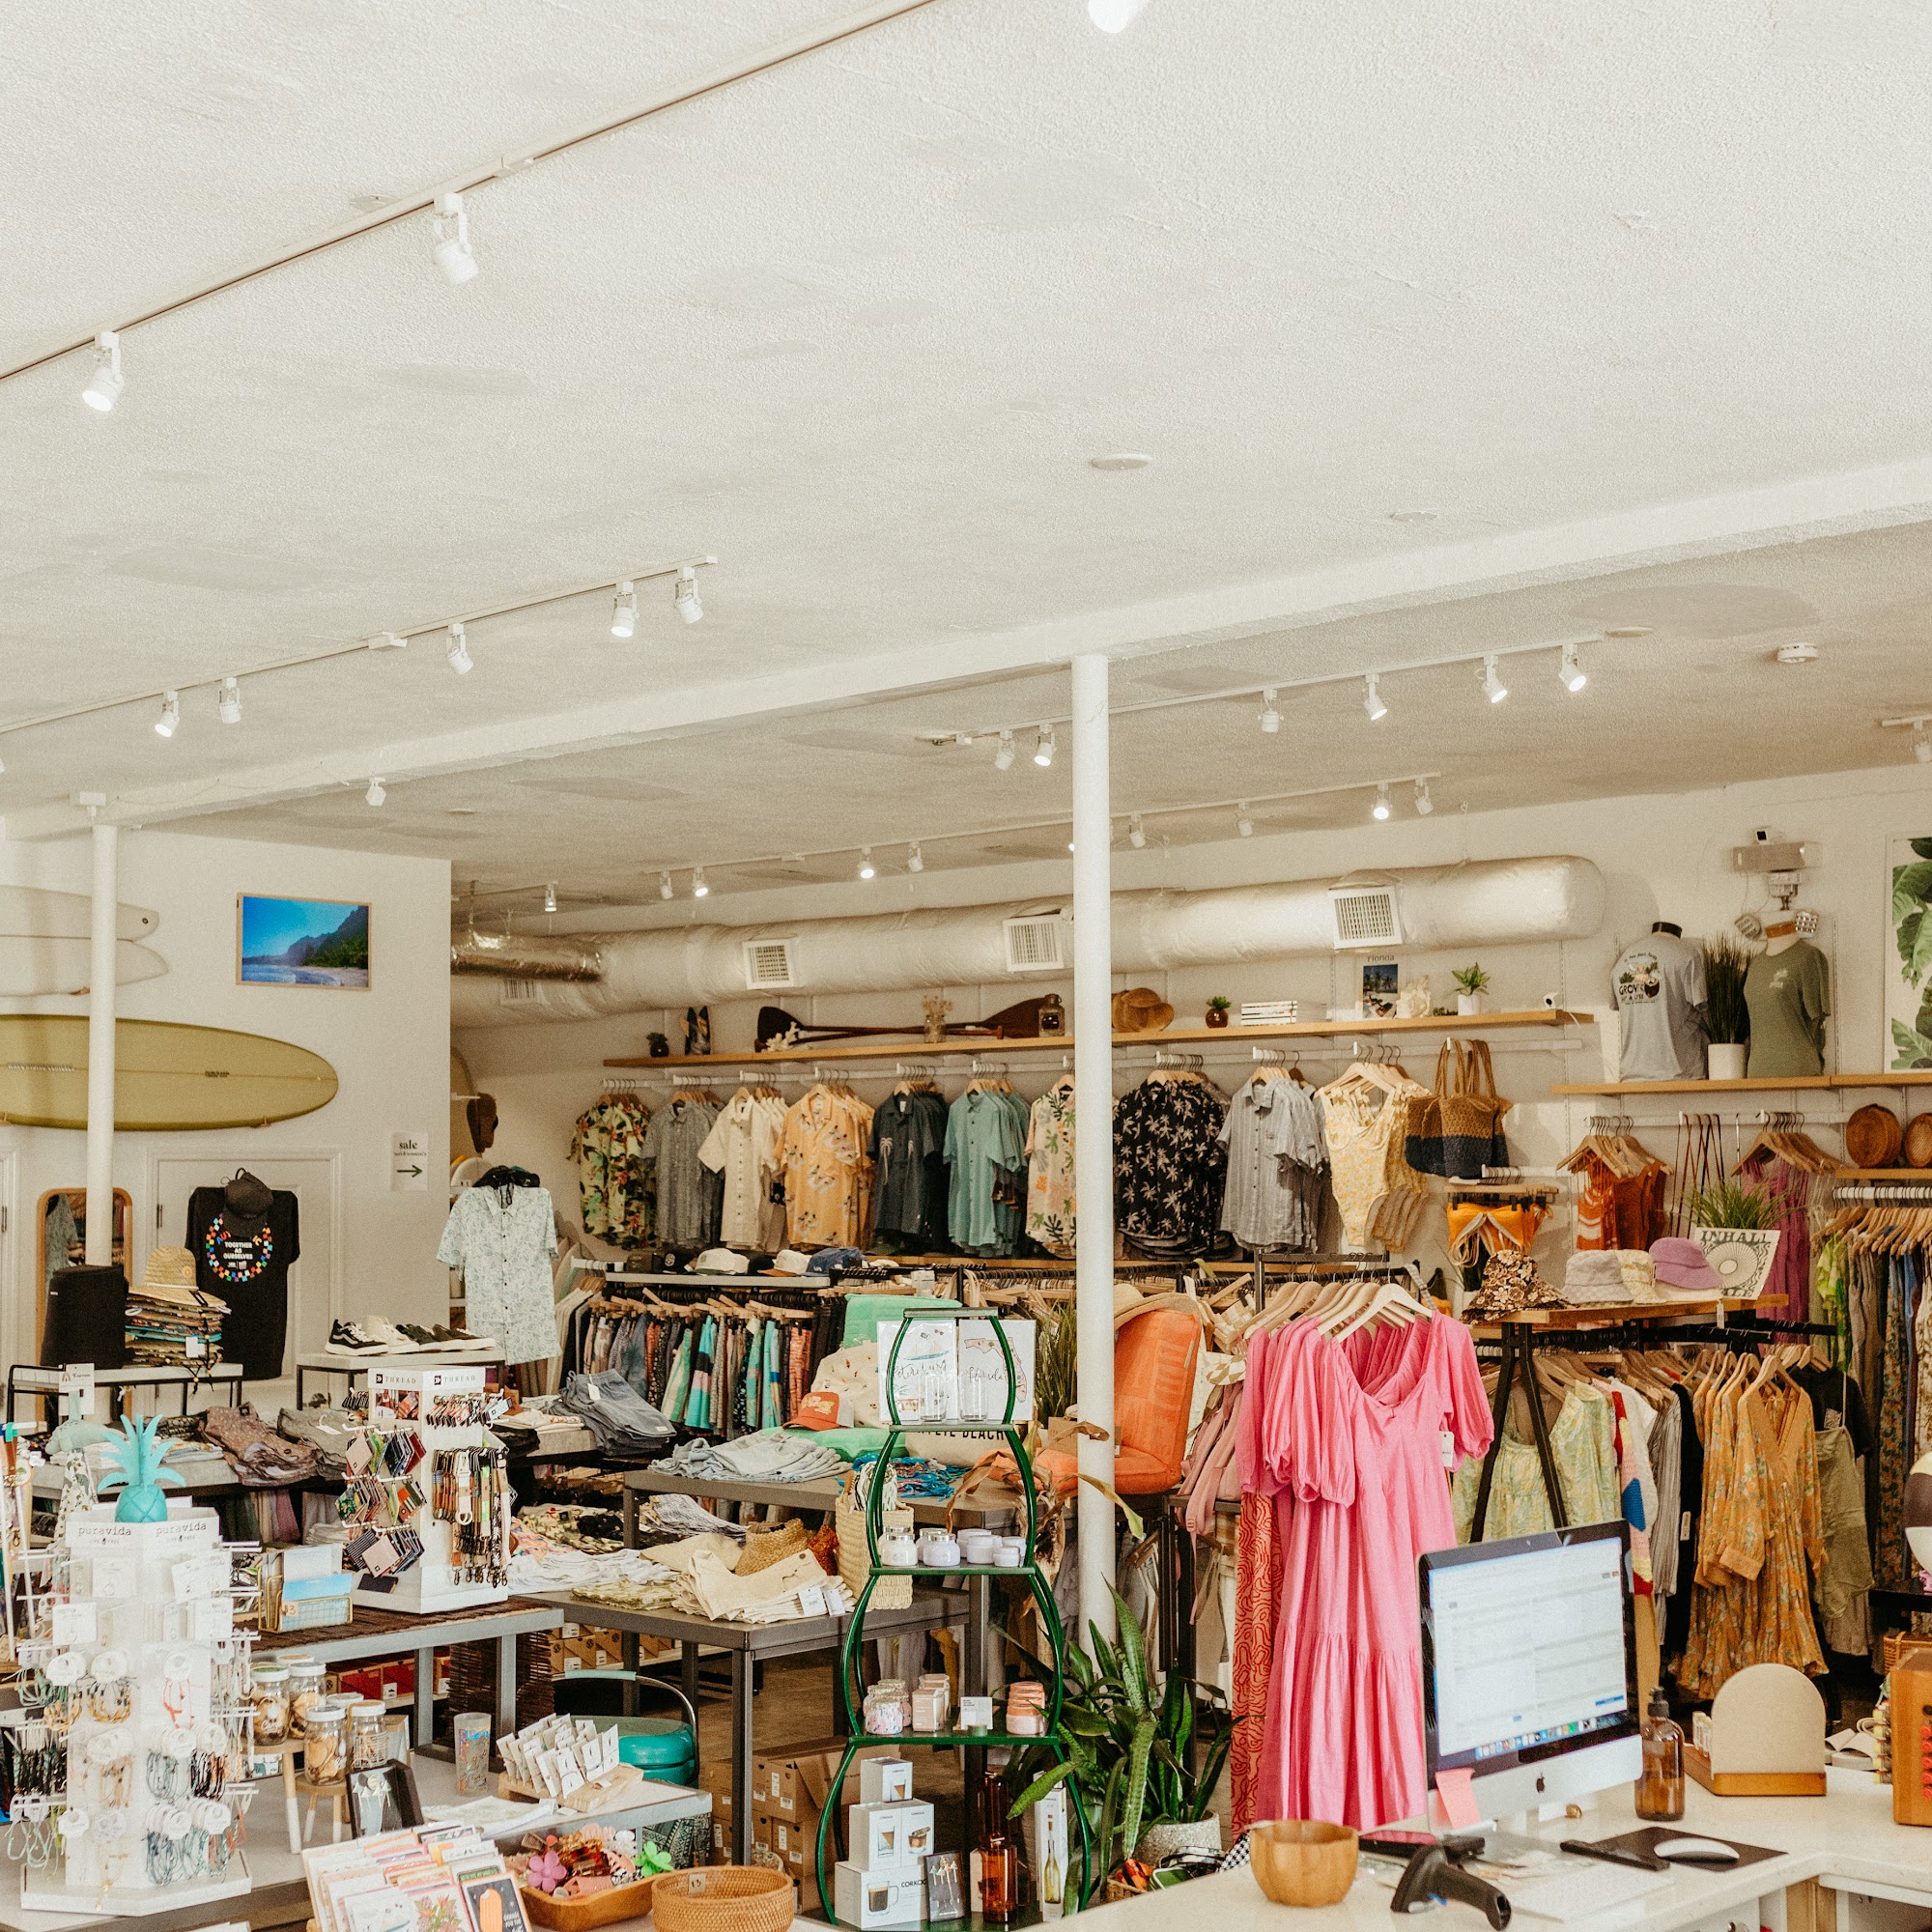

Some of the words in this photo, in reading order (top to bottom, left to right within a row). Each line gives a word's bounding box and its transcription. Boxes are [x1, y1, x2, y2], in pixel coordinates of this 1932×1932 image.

[399, 1140, 417, 1150] sale
[385, 1376, 416, 1384] THREAD
[444, 1375, 476, 1383] THREAD
[78, 1526, 131, 1536] puravida
[156, 1521, 207, 1537] puravida
